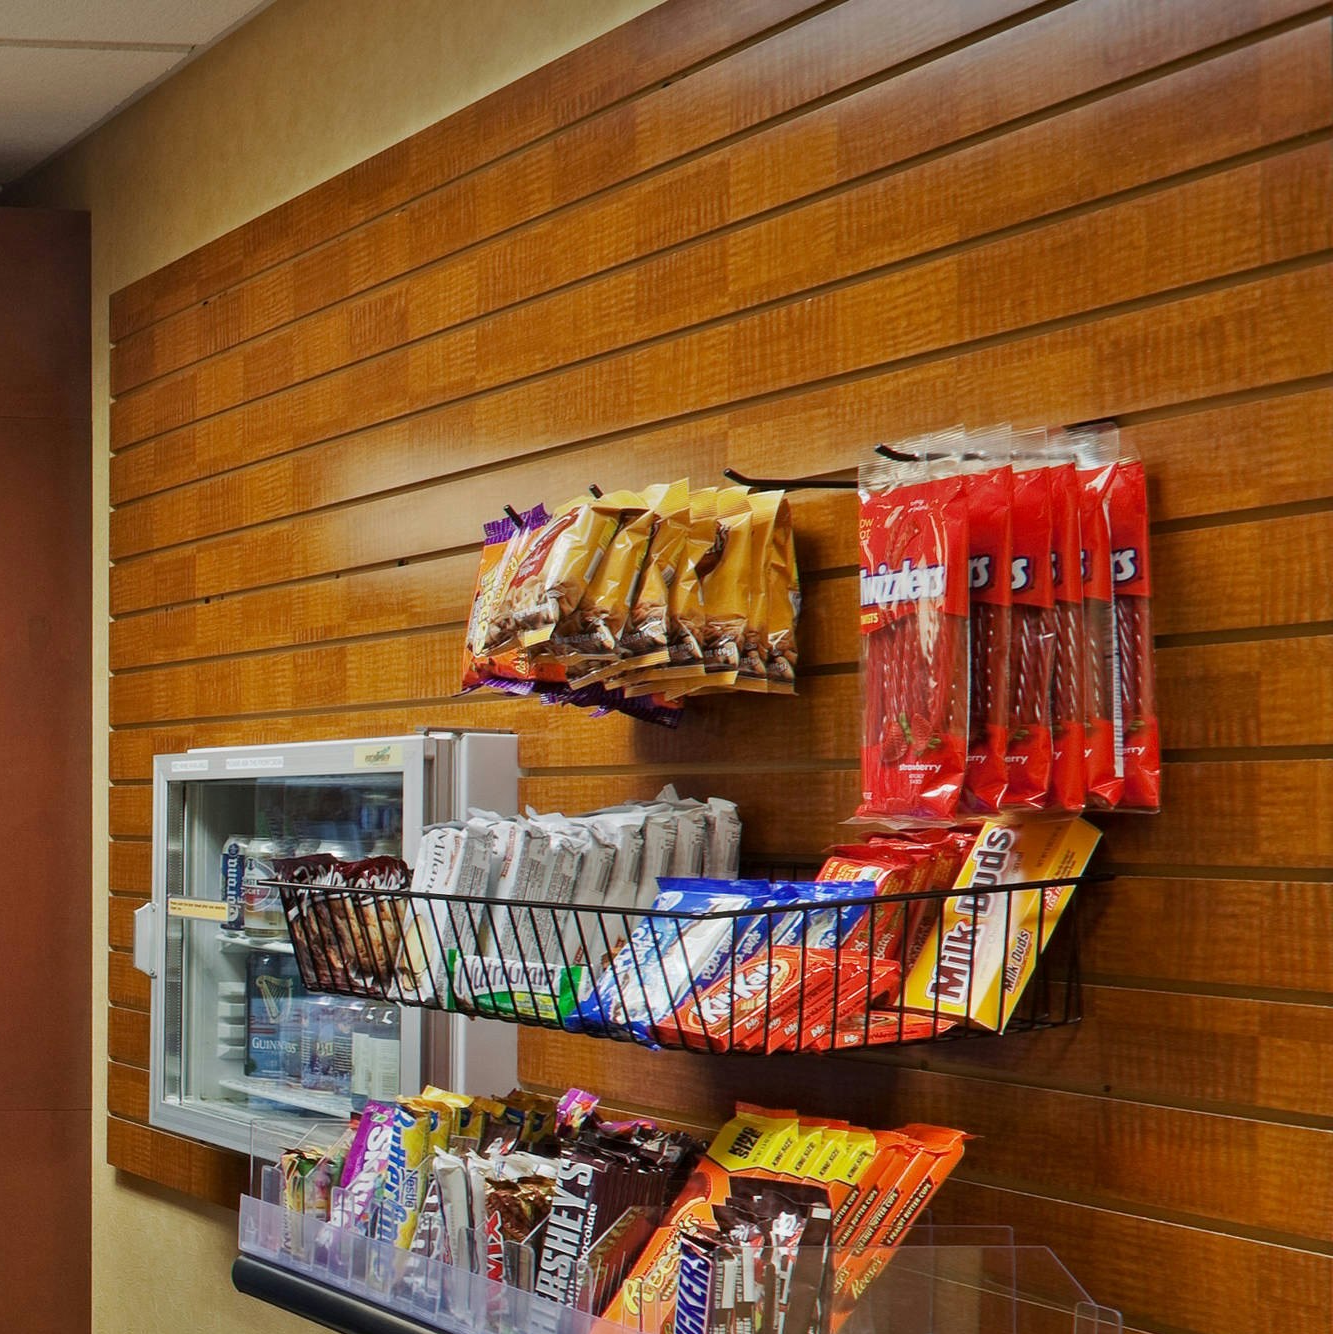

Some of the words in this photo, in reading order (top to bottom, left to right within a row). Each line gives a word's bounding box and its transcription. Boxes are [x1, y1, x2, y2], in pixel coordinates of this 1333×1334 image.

[859, 557, 946, 606] wizzlers
[926, 920, 974, 1006] Milk
[955, 827, 1015, 917] Duds
[1004, 958, 1021, 994] Milk
[1014, 929, 1031, 964] Duds
[728, 1126, 756, 1156] KING
[735, 1129, 765, 1160] SIZE
[847, 1190, 860, 1208] CUPS
[867, 1190, 878, 1207] CUPS
[887, 1192, 899, 1211] CUPS
[890, 1218, 905, 1240] PEANUT
[904, 1199, 920, 1222] BUTTER
[919, 1183, 933, 1202] CUPS
[851, 1256, 883, 1300] Reese's
